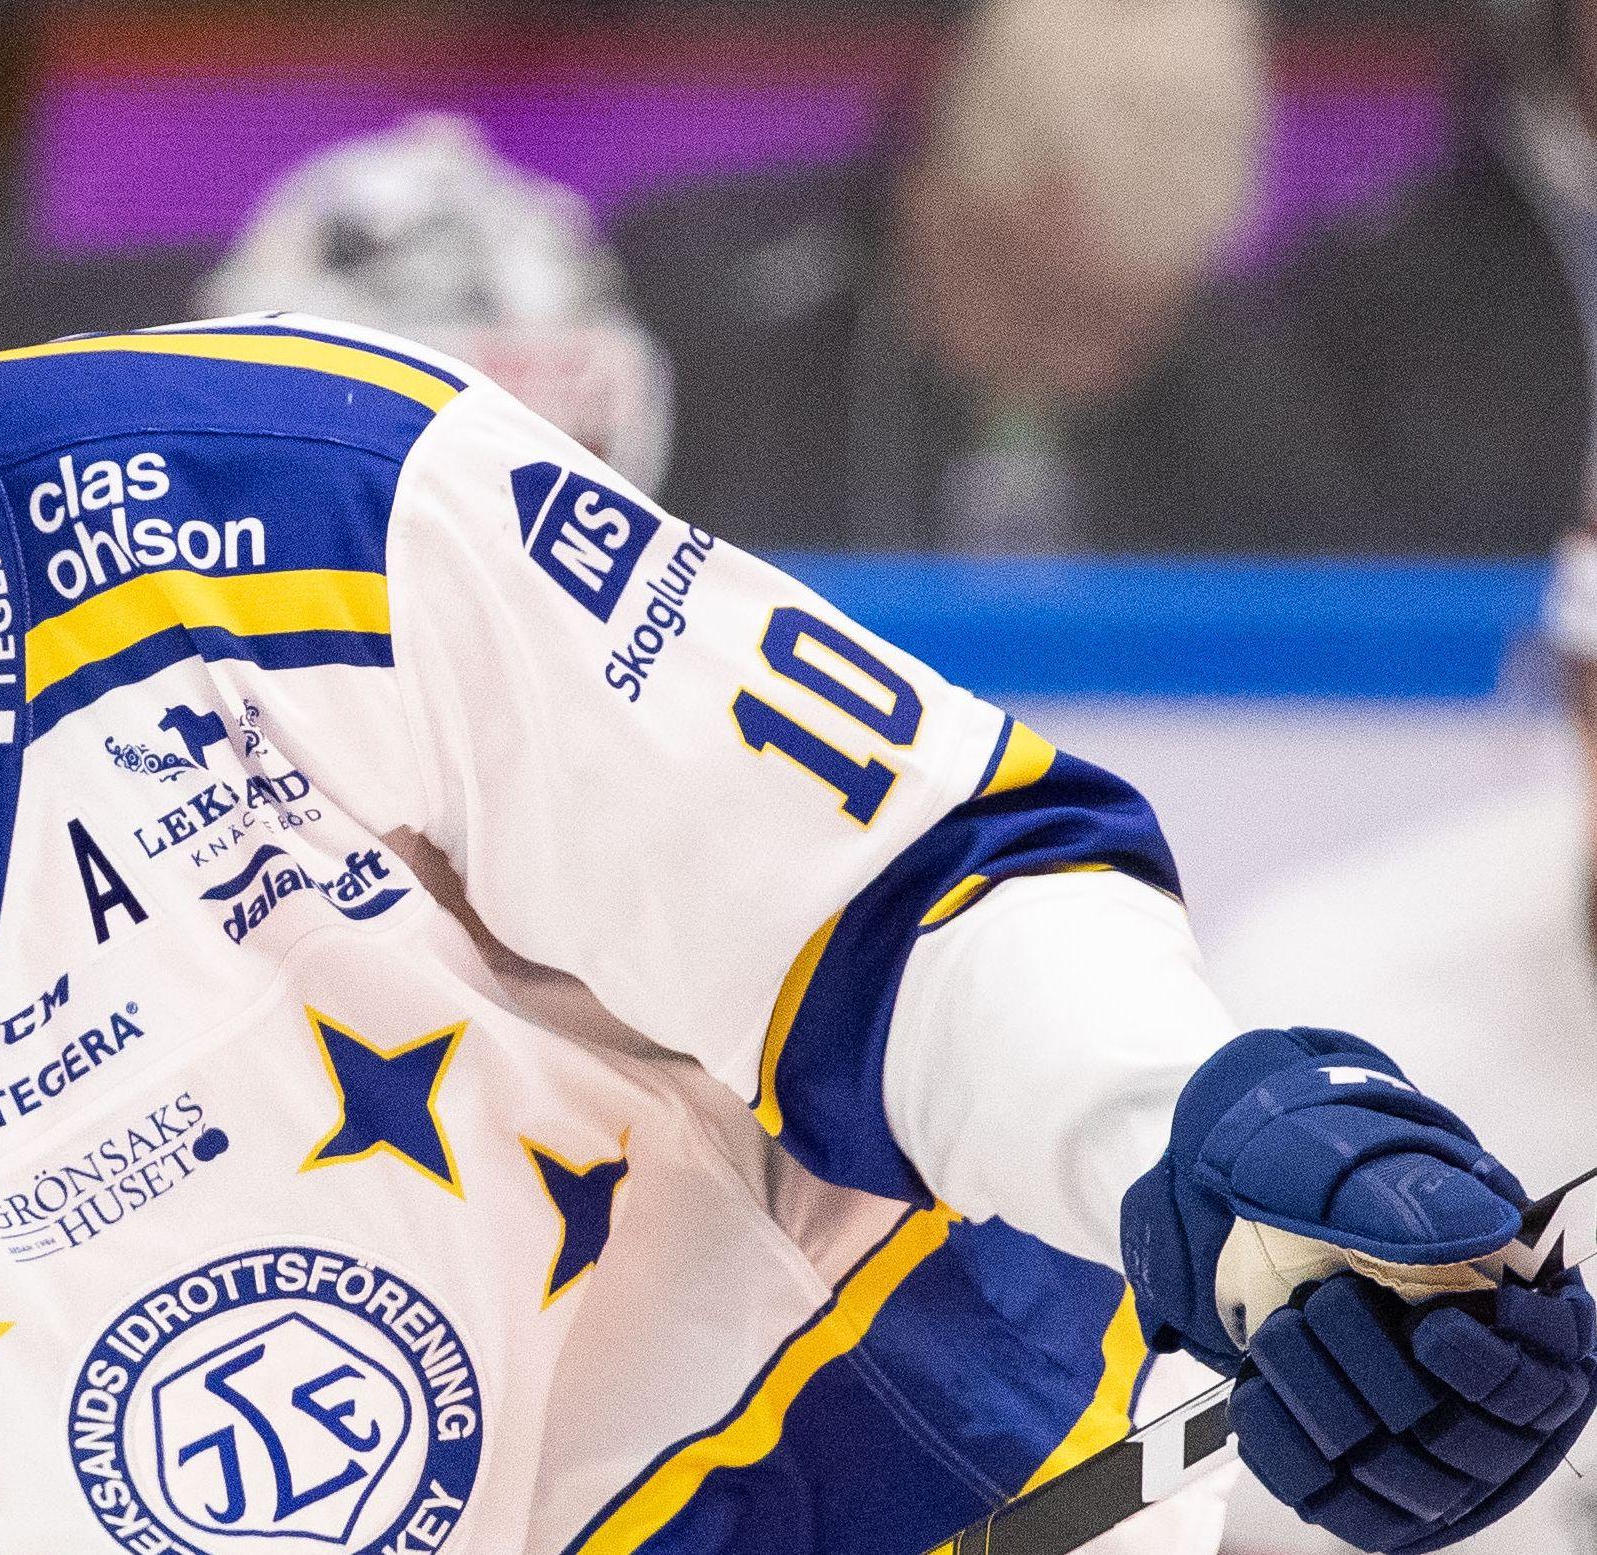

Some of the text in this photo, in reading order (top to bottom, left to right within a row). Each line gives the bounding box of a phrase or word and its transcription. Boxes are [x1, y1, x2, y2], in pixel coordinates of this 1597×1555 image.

[29, 452, 170, 534] clas
[550, 490, 632, 593] NS
[47, 508, 266, 600] ohlson
[729, 604, 924, 830] 10
[68, 818, 149, 945] A
[55, 1143, 194, 1248] HUSET
[74, 1254, 477, 1555] EKSANDS IDROTTSFÖRENING
